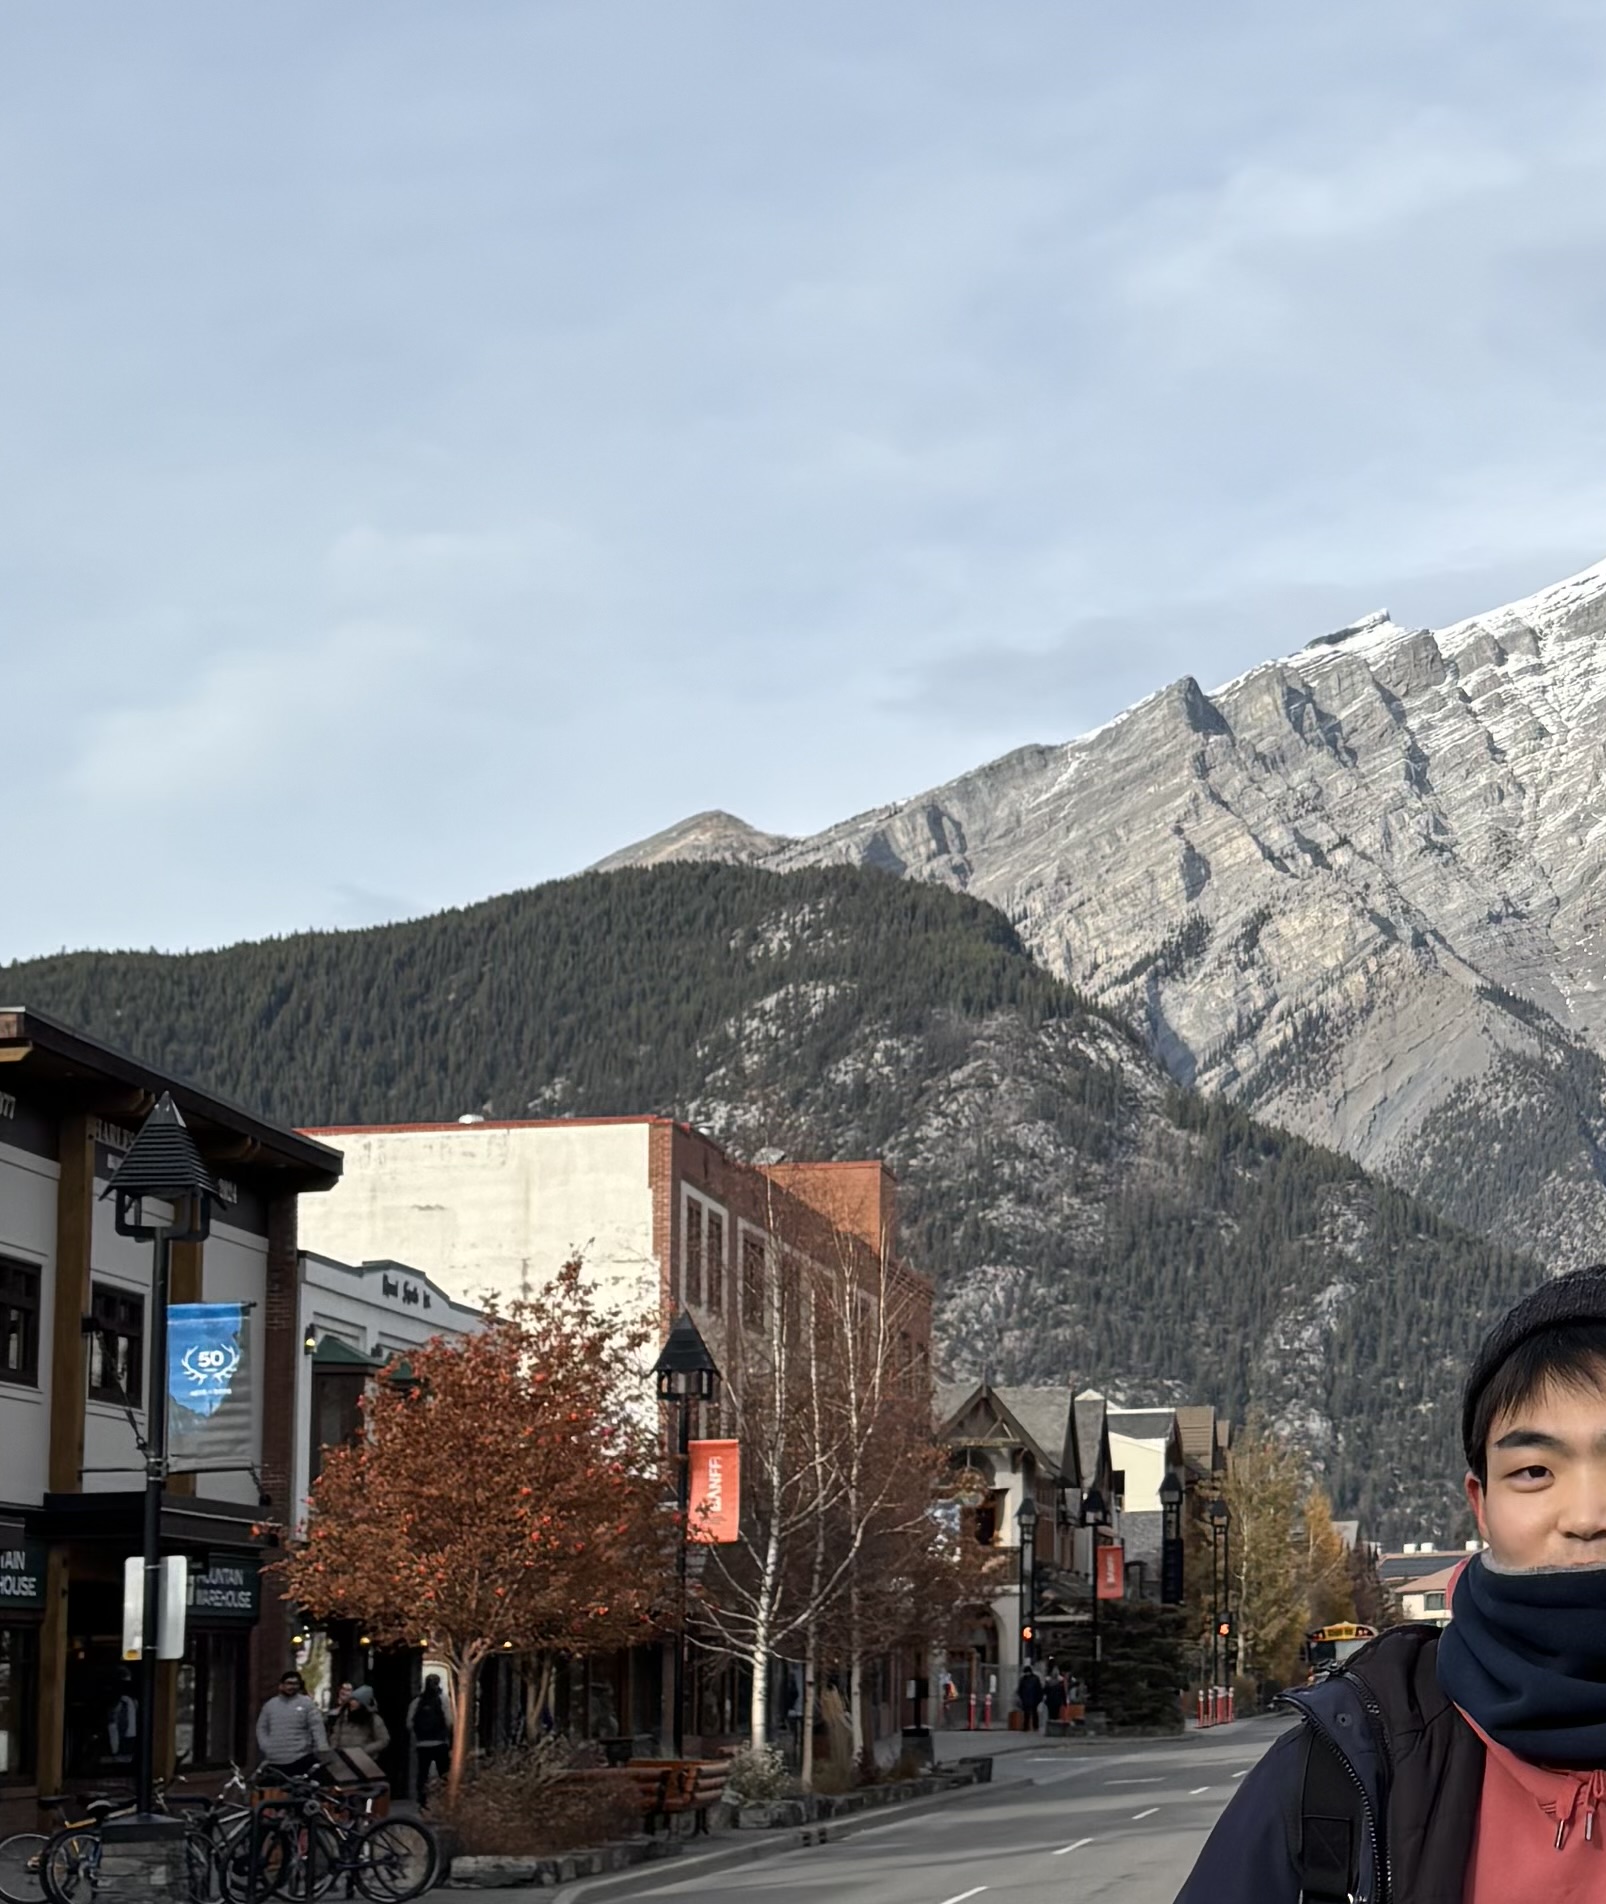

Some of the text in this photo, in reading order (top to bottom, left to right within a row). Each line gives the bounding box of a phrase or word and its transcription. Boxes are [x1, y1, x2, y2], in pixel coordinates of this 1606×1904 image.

[198, 1350, 224, 1367] 50
[708, 1456, 722, 1511] BANFF
[196, 1589, 252, 1609] WAREHOUSE
